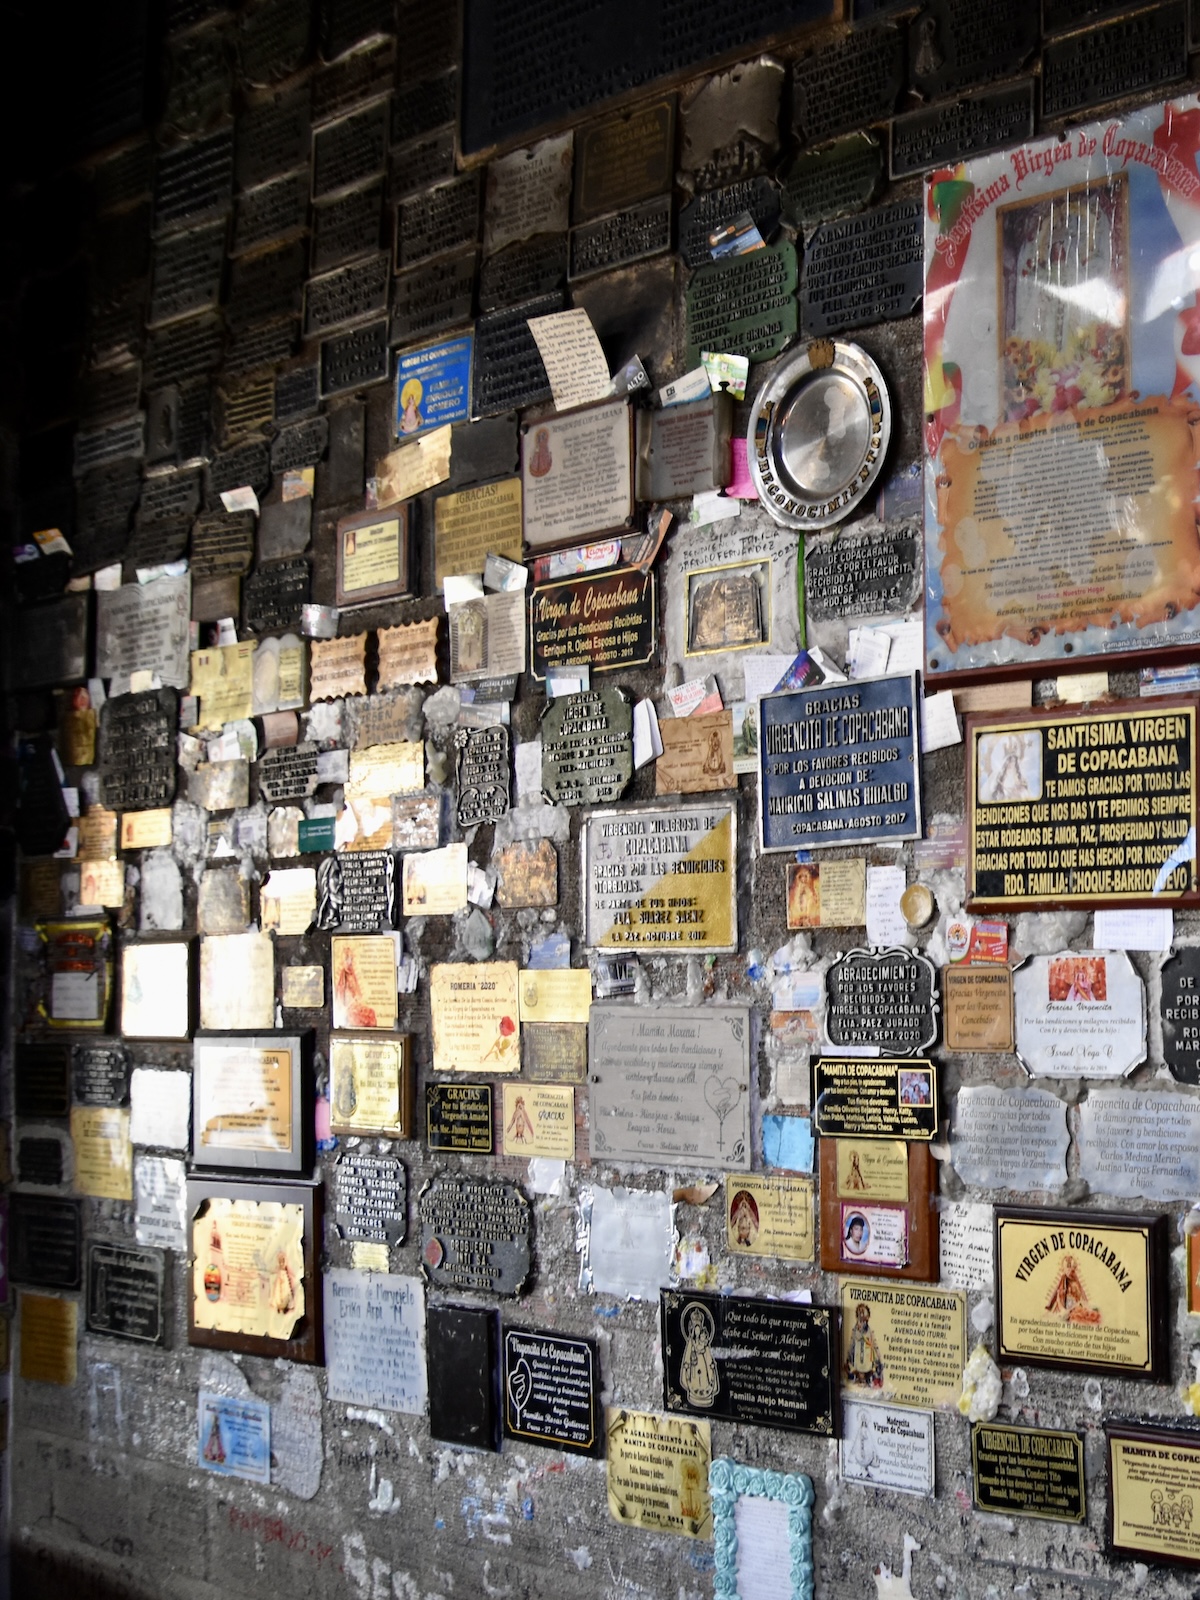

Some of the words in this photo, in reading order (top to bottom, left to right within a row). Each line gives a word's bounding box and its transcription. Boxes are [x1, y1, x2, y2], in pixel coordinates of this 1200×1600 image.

[1010, 140, 1073, 190] Virgen
[1078, 130, 1097, 156] de
[570, 592, 580, 615] de
[806, 694, 860, 716] GRACIAS
[766, 719, 822, 755] VIRGENCITA
[826, 715, 839, 747] DE
[842, 707, 909, 745] COPACABANA
[1047, 724, 1125, 749] SANTISIMA
[1130, 717, 1186, 742] VIRGEN
[1058, 753, 1077, 774] DE
[1080, 744, 1179, 772] COPACABANA
[1046, 780, 1055, 798] TE
[1058, 779, 1086, 796] DAMOS
[1087, 775, 1123, 794] GRACIAS
[1126, 774, 1142, 792] POR
[1144, 772, 1172, 790] TODAS
[1175, 770, 1191, 788] LAS
[768, 794, 813, 815] MAURICIO
[817, 788, 860, 811] SALINAS
[863, 783, 908, 805] HIDALGO
[602, 822, 645, 837] VIRGENCITA
[838, 965, 917, 981] AGRADECIMIENTO
[1180, 978, 1194, 988] DE
[447, 1089, 480, 1100] GRACIAS
[1016, 1238, 1050, 1283] VIRGEN
[1051, 1232, 1065, 1251] DE
[1069, 1231, 1133, 1293] COPACABANA
[850, 1288, 891, 1306] VIRGENCITA
[892, 1293, 905, 1305] DE
[906, 1294, 957, 1311] COPACABANA
[730, 1391, 755, 1402] Familia
[757, 1394, 776, 1405] Alejo
[1122, 1446, 1157, 1459] MAMITA
[1159, 1451, 1169, 1460] DE
